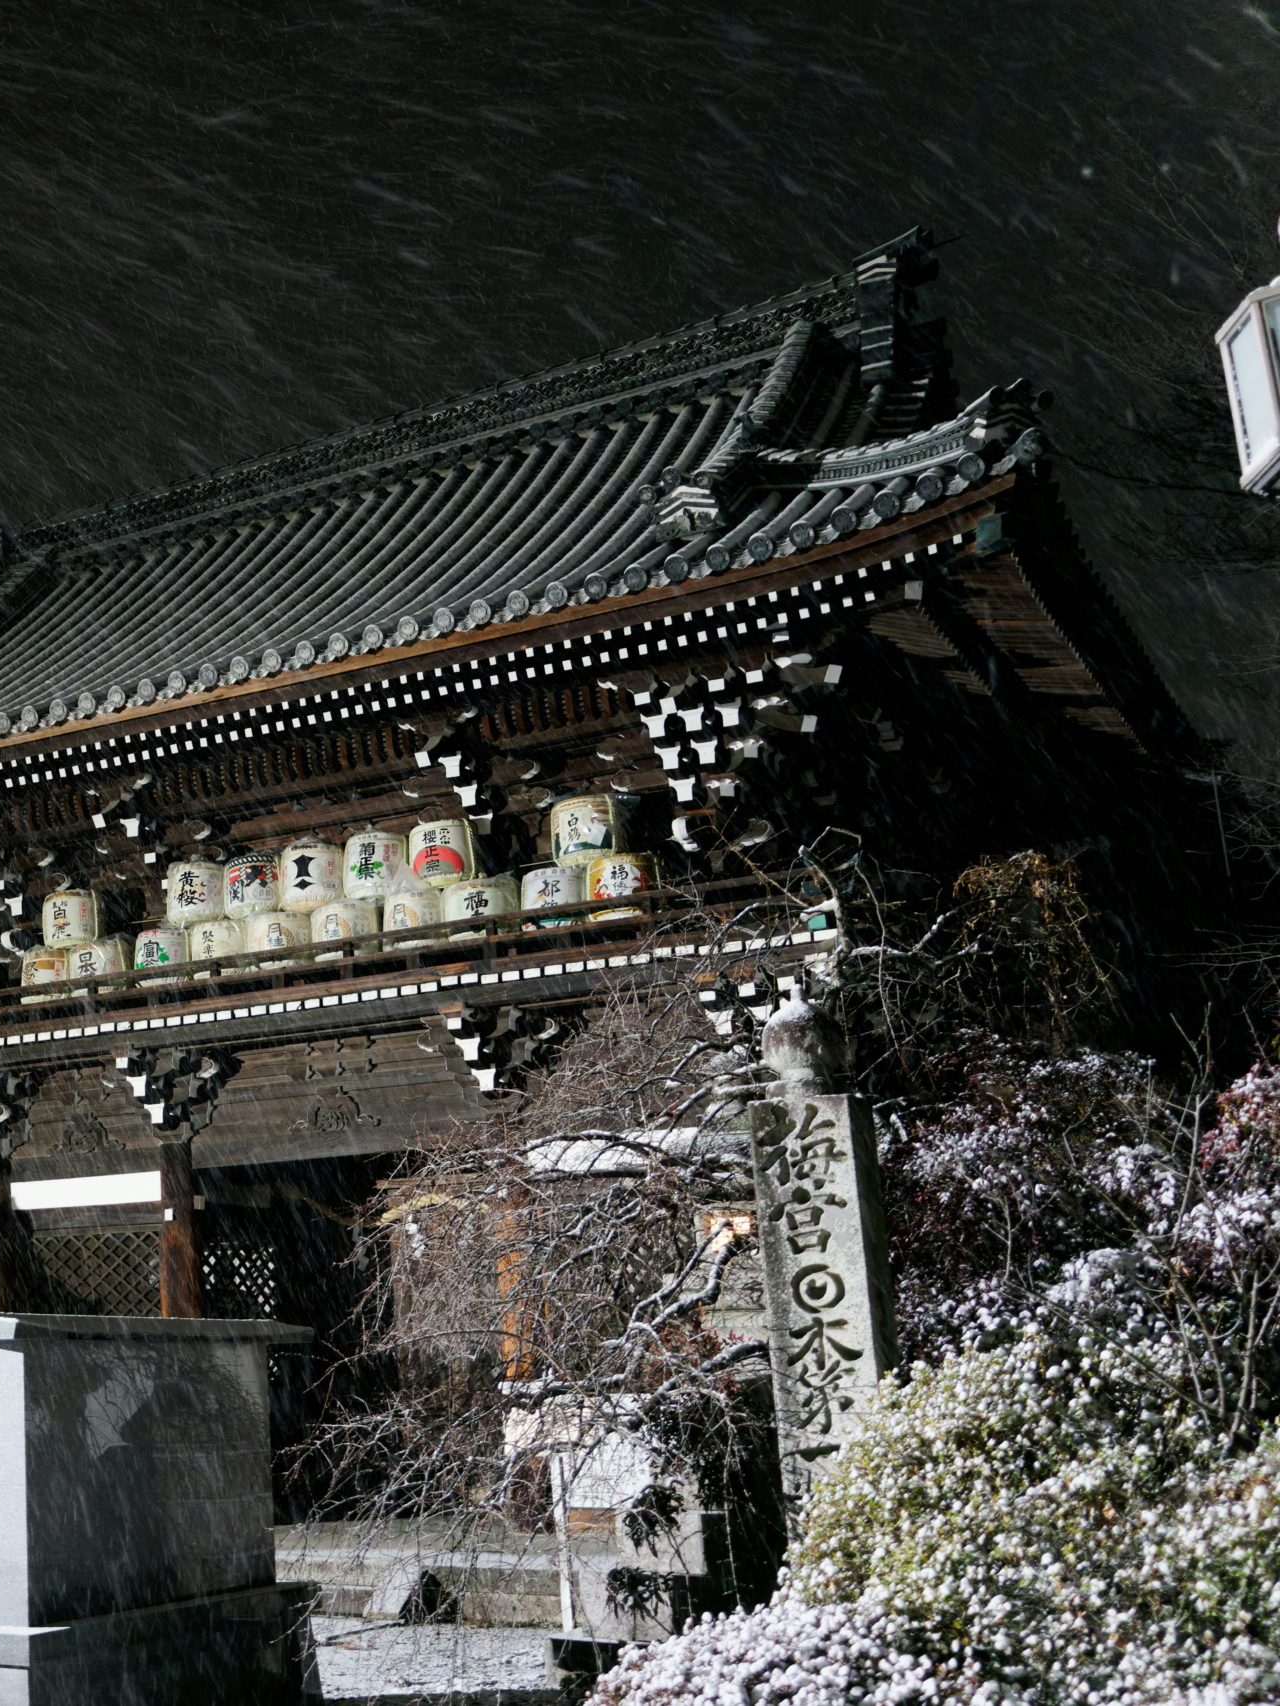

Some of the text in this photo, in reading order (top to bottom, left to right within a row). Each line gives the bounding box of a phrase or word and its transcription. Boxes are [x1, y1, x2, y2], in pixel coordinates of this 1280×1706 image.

[358, 842, 376, 881] 菊正宗
[78, 951, 98, 978] 日本
